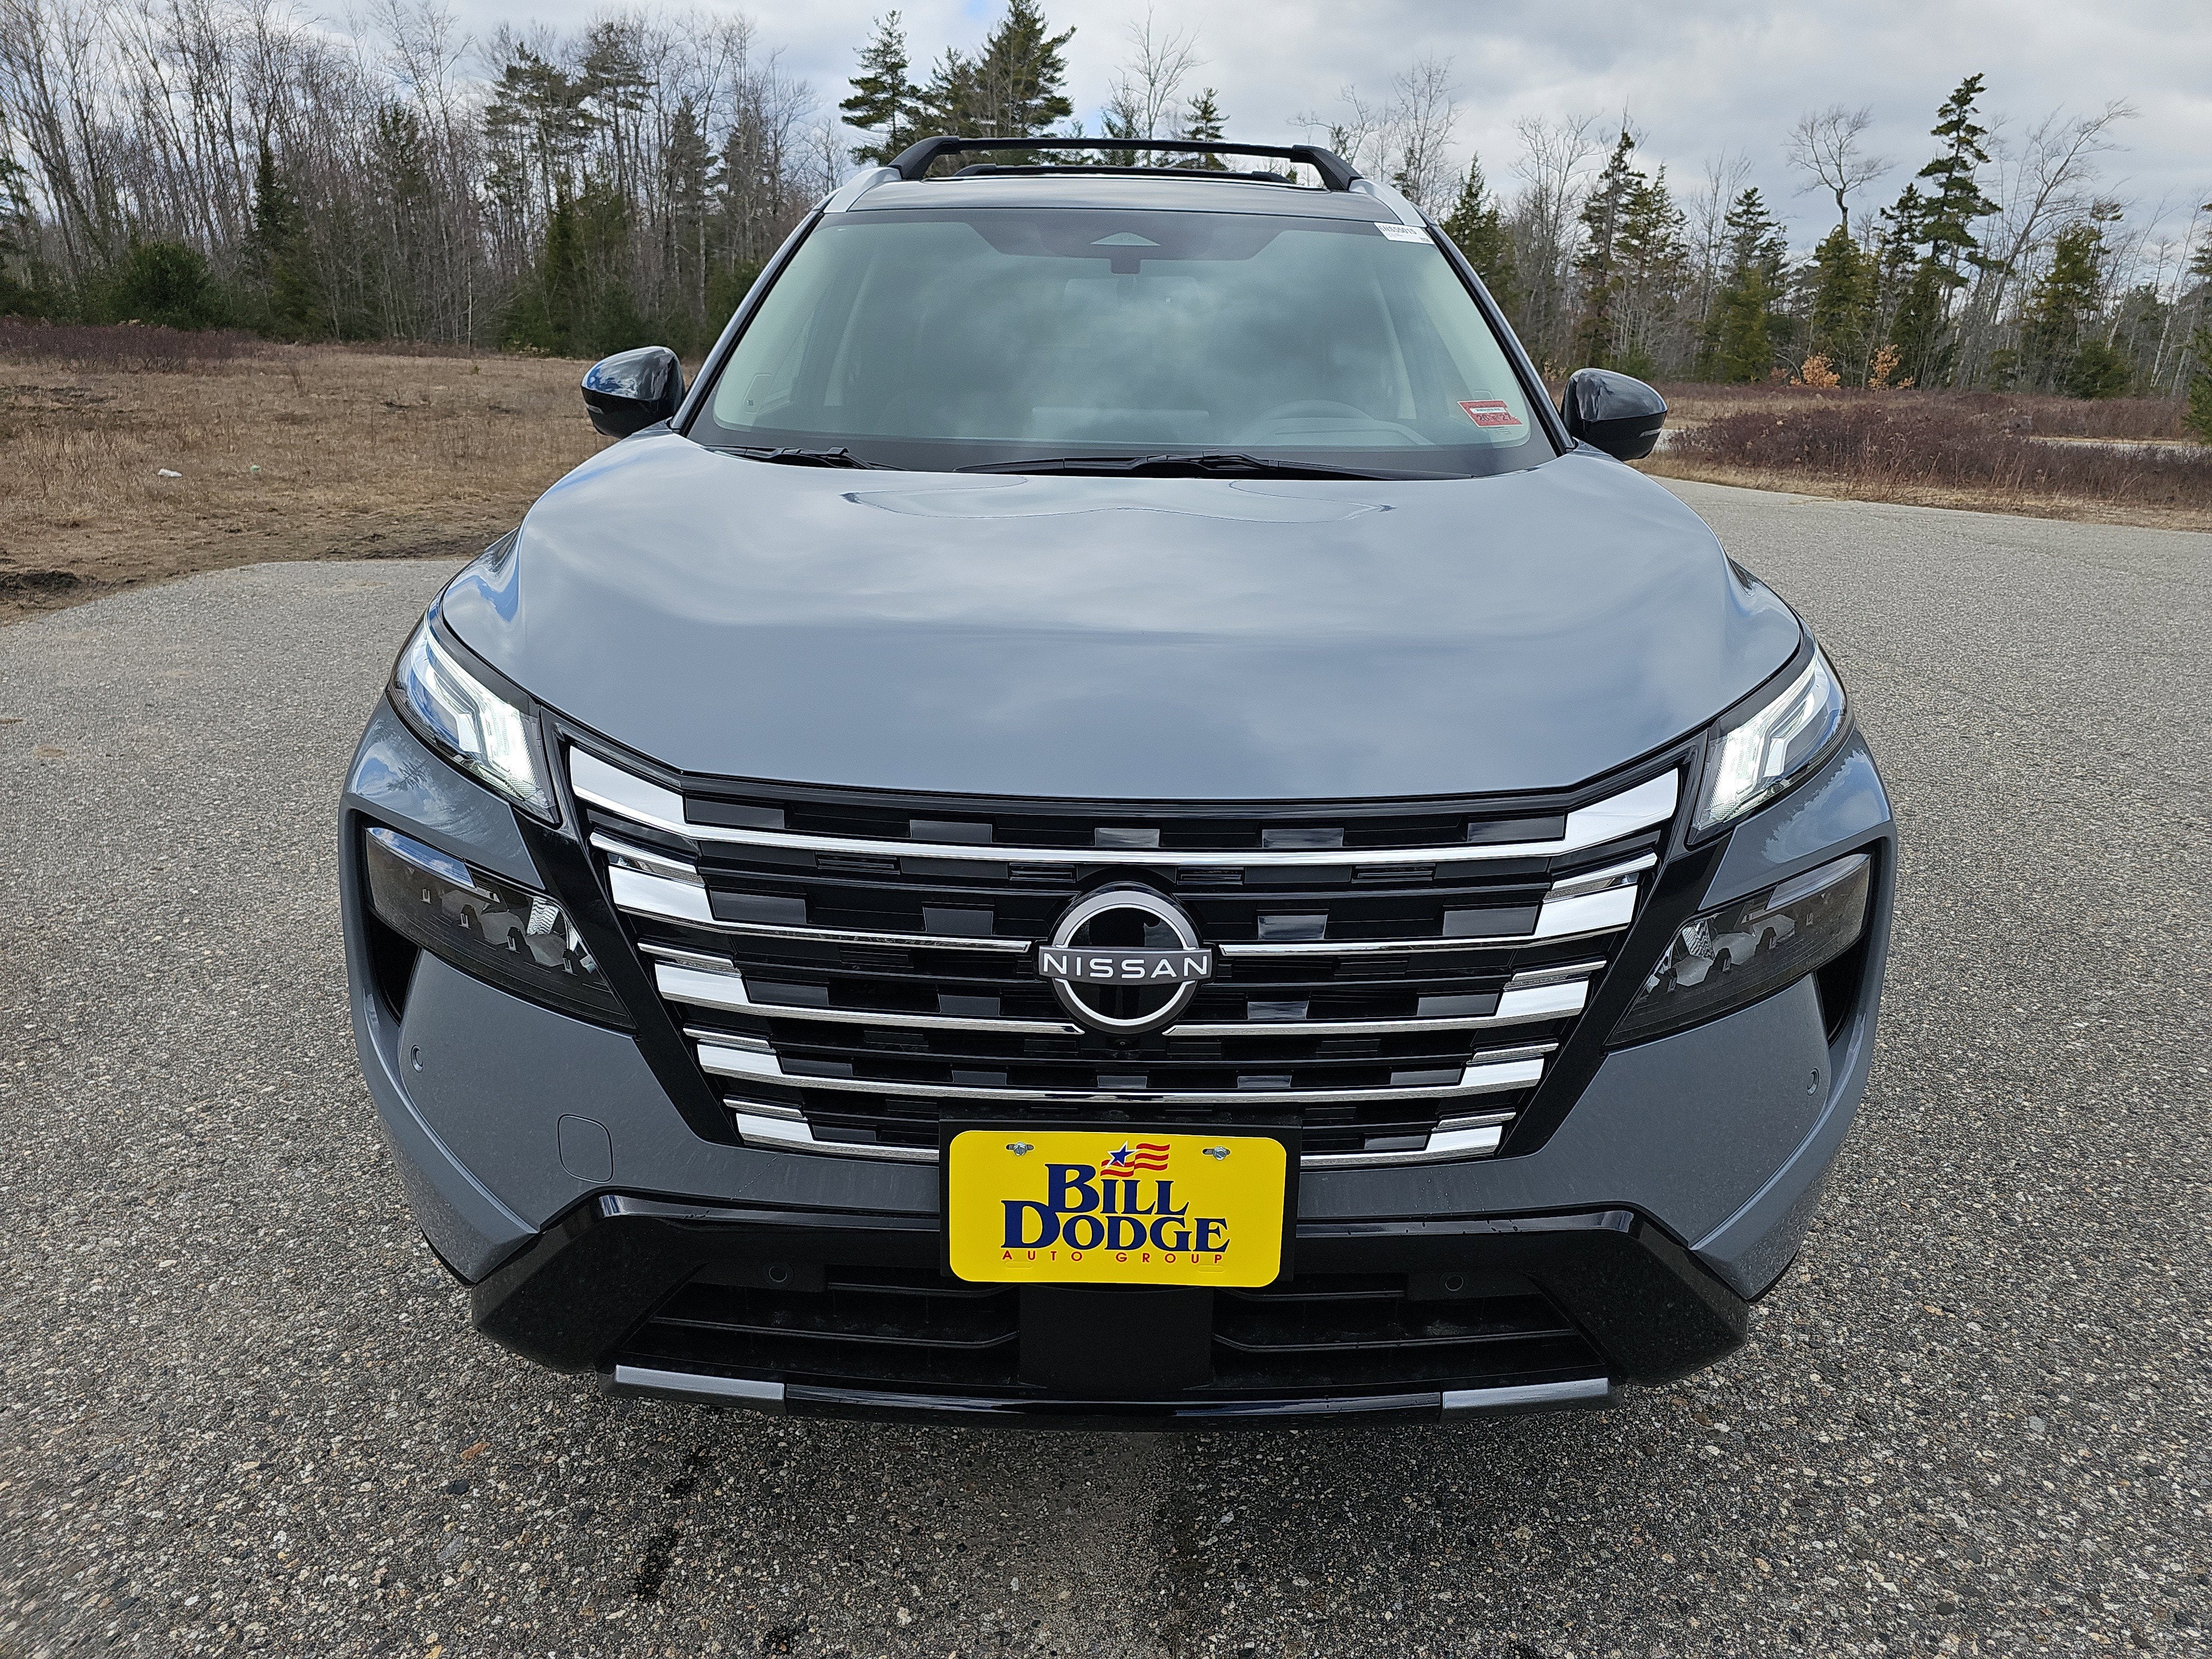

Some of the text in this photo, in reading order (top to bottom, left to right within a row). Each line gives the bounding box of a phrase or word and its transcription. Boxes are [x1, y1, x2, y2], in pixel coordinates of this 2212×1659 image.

[1043, 953, 1208, 979] NISSAN
[1045, 1163, 1189, 1216] BILL
[1001, 1200, 1230, 1252] DODGE
[1002, 1250, 1223, 1264] AUTO GROUP
